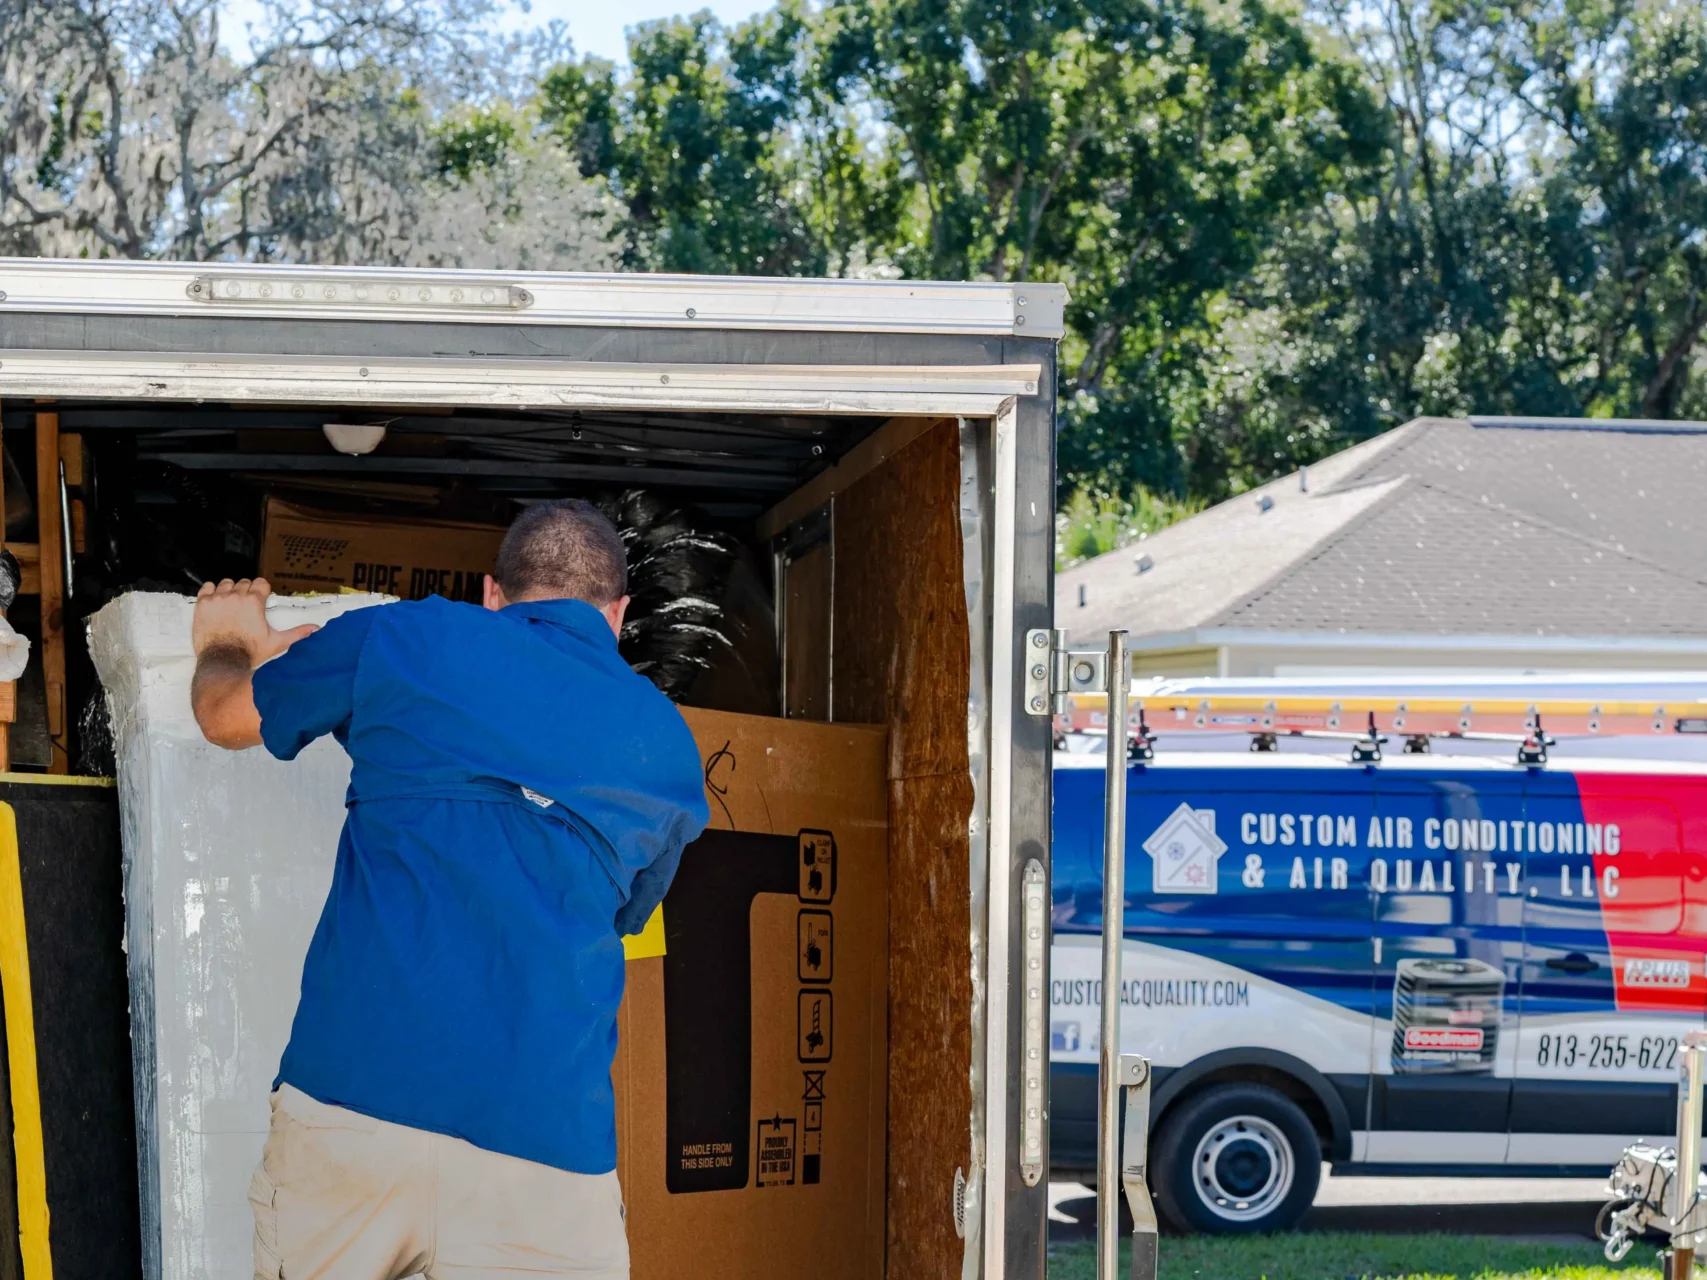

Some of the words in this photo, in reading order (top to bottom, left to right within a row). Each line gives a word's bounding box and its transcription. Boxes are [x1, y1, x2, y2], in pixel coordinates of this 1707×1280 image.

[353, 562, 402, 595] PIPE
[1241, 812, 1357, 848] CUSTOM
[1367, 816, 1413, 849] AIR
[1424, 817, 1621, 856] CONDITIONING
[1242, 853, 1266, 888] &
[1289, 856, 1348, 890] AIR
[1560, 864, 1620, 898] LLC
[1051, 979, 1249, 1009] CUSTOACQUALITY.COM
[1537, 1034, 1678, 1070] 813-255-622
[681, 1158, 697, 1170] THIS
[698, 1157, 714, 1169] SIDE
[715, 1156, 734, 1168] ONLY
[682, 1144, 711, 1156] HANDLE
[712, 1143, 732, 1154] FROM
[768, 1162, 779, 1173] THE
[779, 1160, 791, 1173] USA
